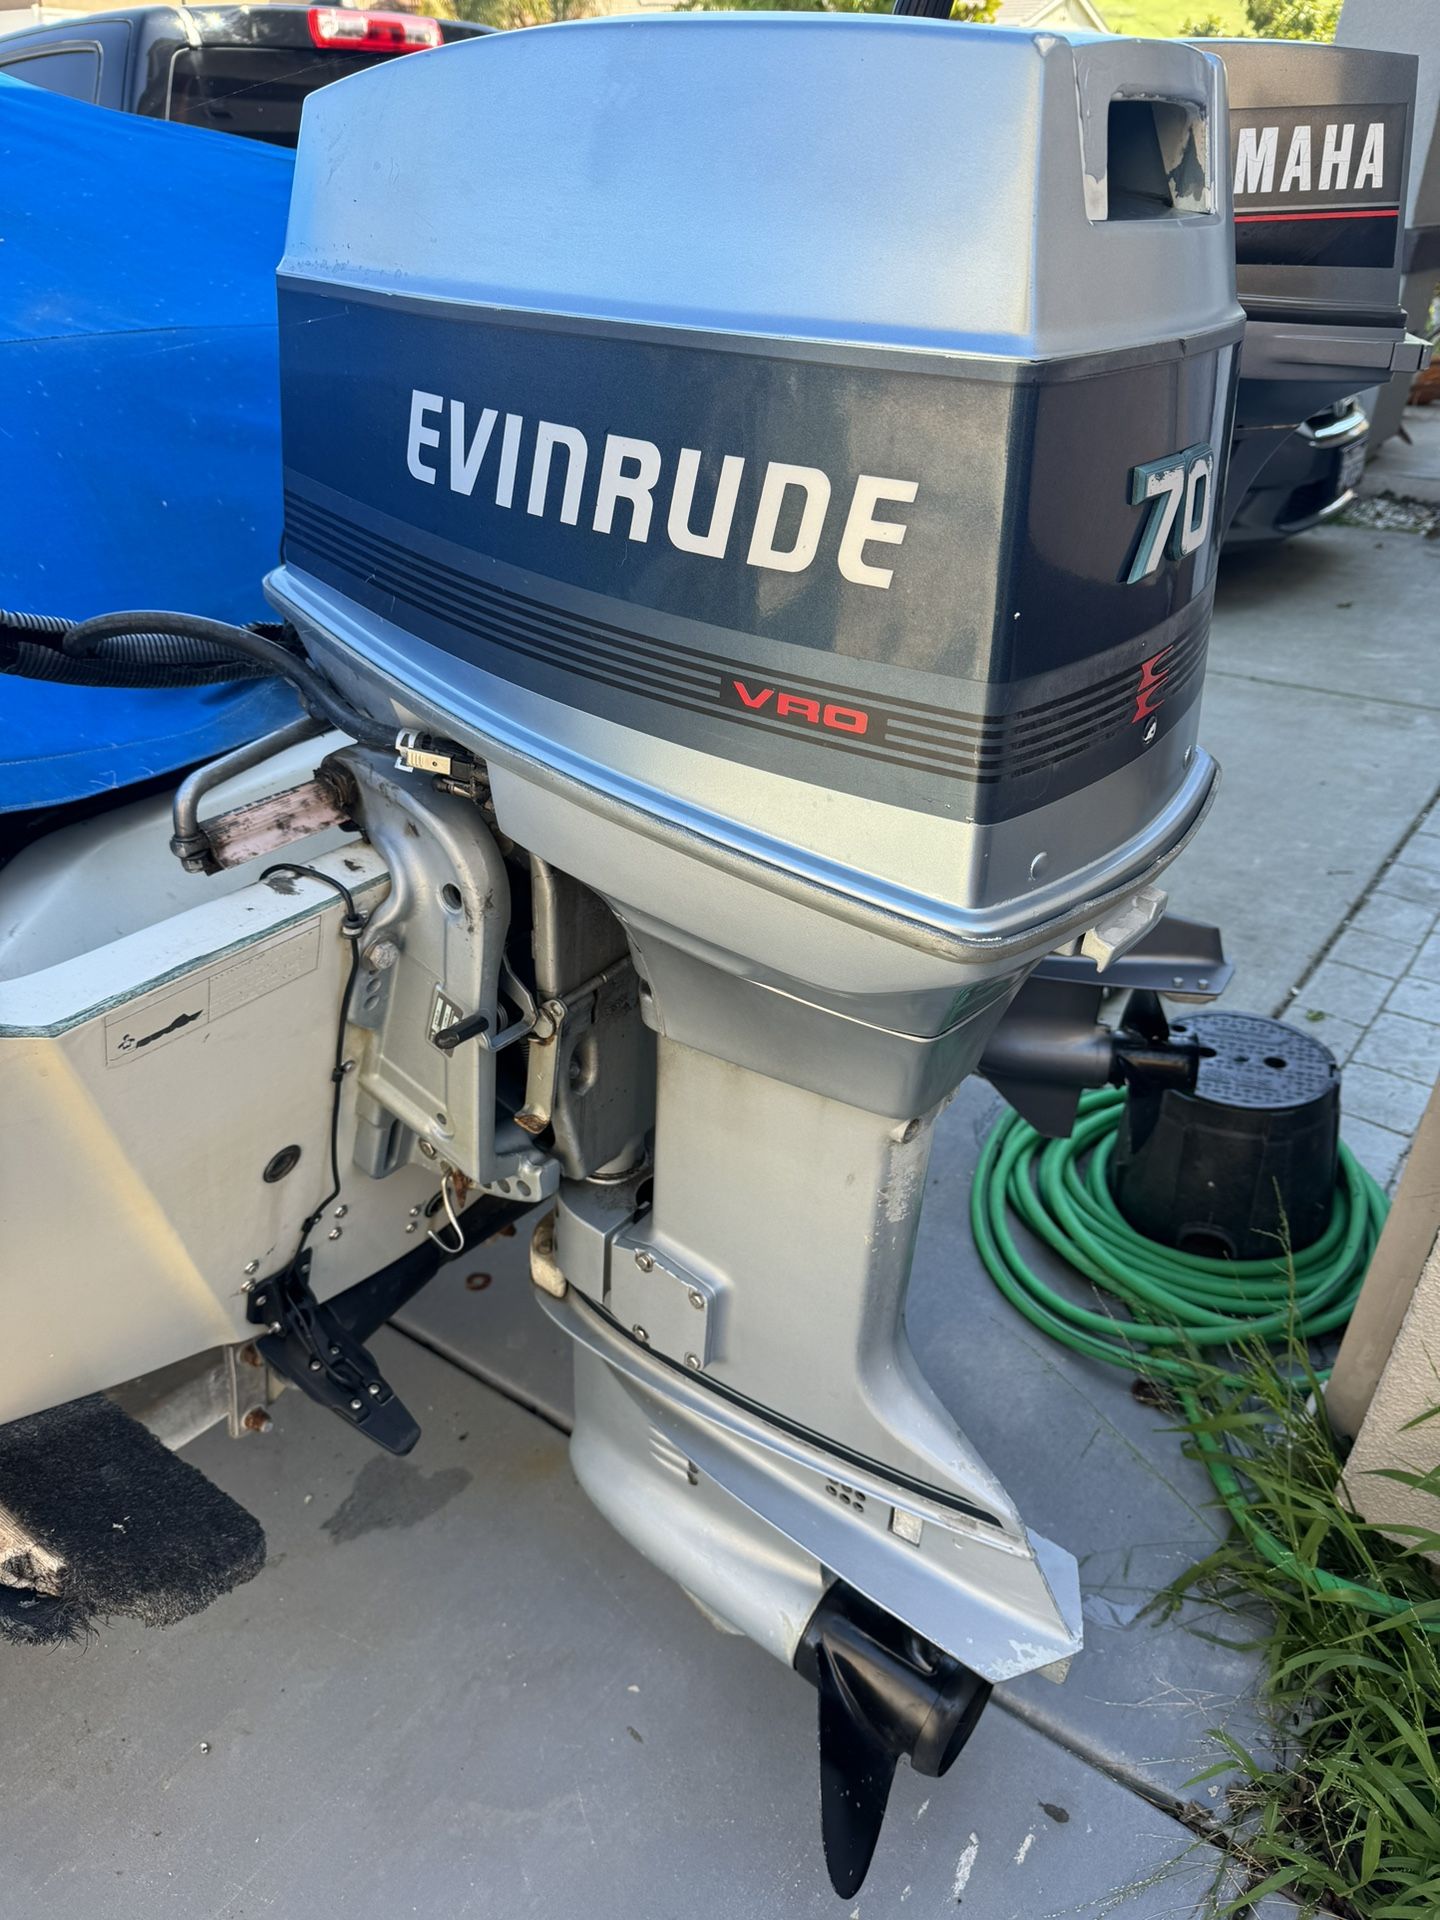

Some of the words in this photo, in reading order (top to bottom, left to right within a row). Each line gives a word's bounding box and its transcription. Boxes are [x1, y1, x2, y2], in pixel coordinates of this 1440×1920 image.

[1233, 123, 1384, 194] MAHA
[406, 389, 919, 590] EVINRUDE
[1131, 445, 1213, 583] 70
[733, 680, 869, 735] VRO
